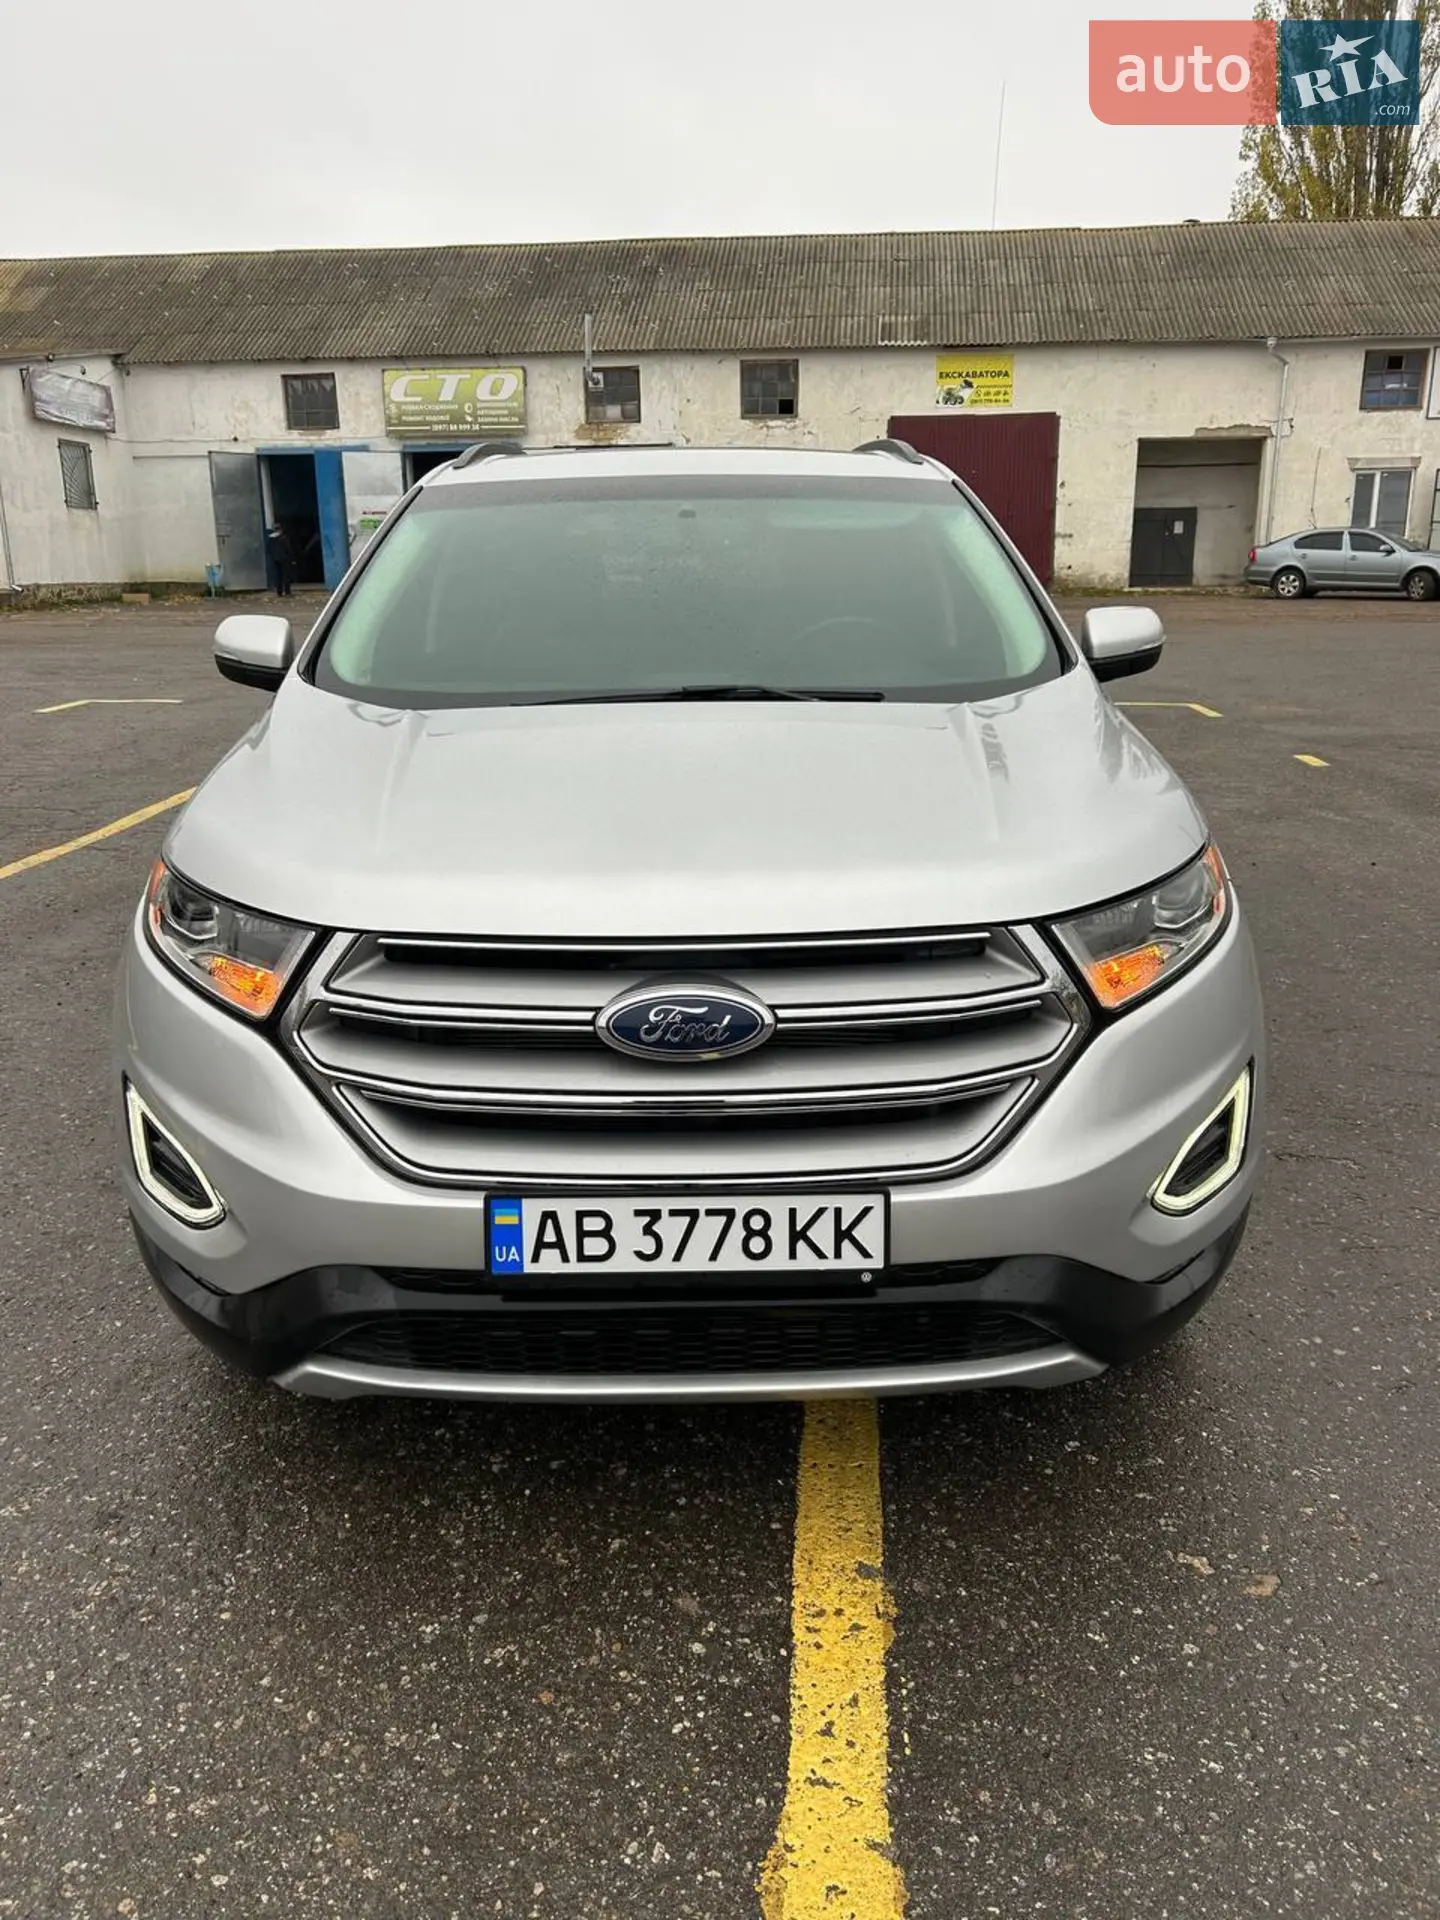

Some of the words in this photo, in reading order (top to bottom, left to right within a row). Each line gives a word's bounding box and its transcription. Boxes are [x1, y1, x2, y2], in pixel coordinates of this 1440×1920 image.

[390, 373, 518, 402] СТО
[939, 370, 1010, 379] ЕКСКАВАТОРА
[640, 1005, 732, 1043] Ford
[495, 1246, 520, 1262] UA
[531, 1210, 617, 1264] AB
[633, 1208, 773, 1262] 3778
[788, 1205, 874, 1261] KK
